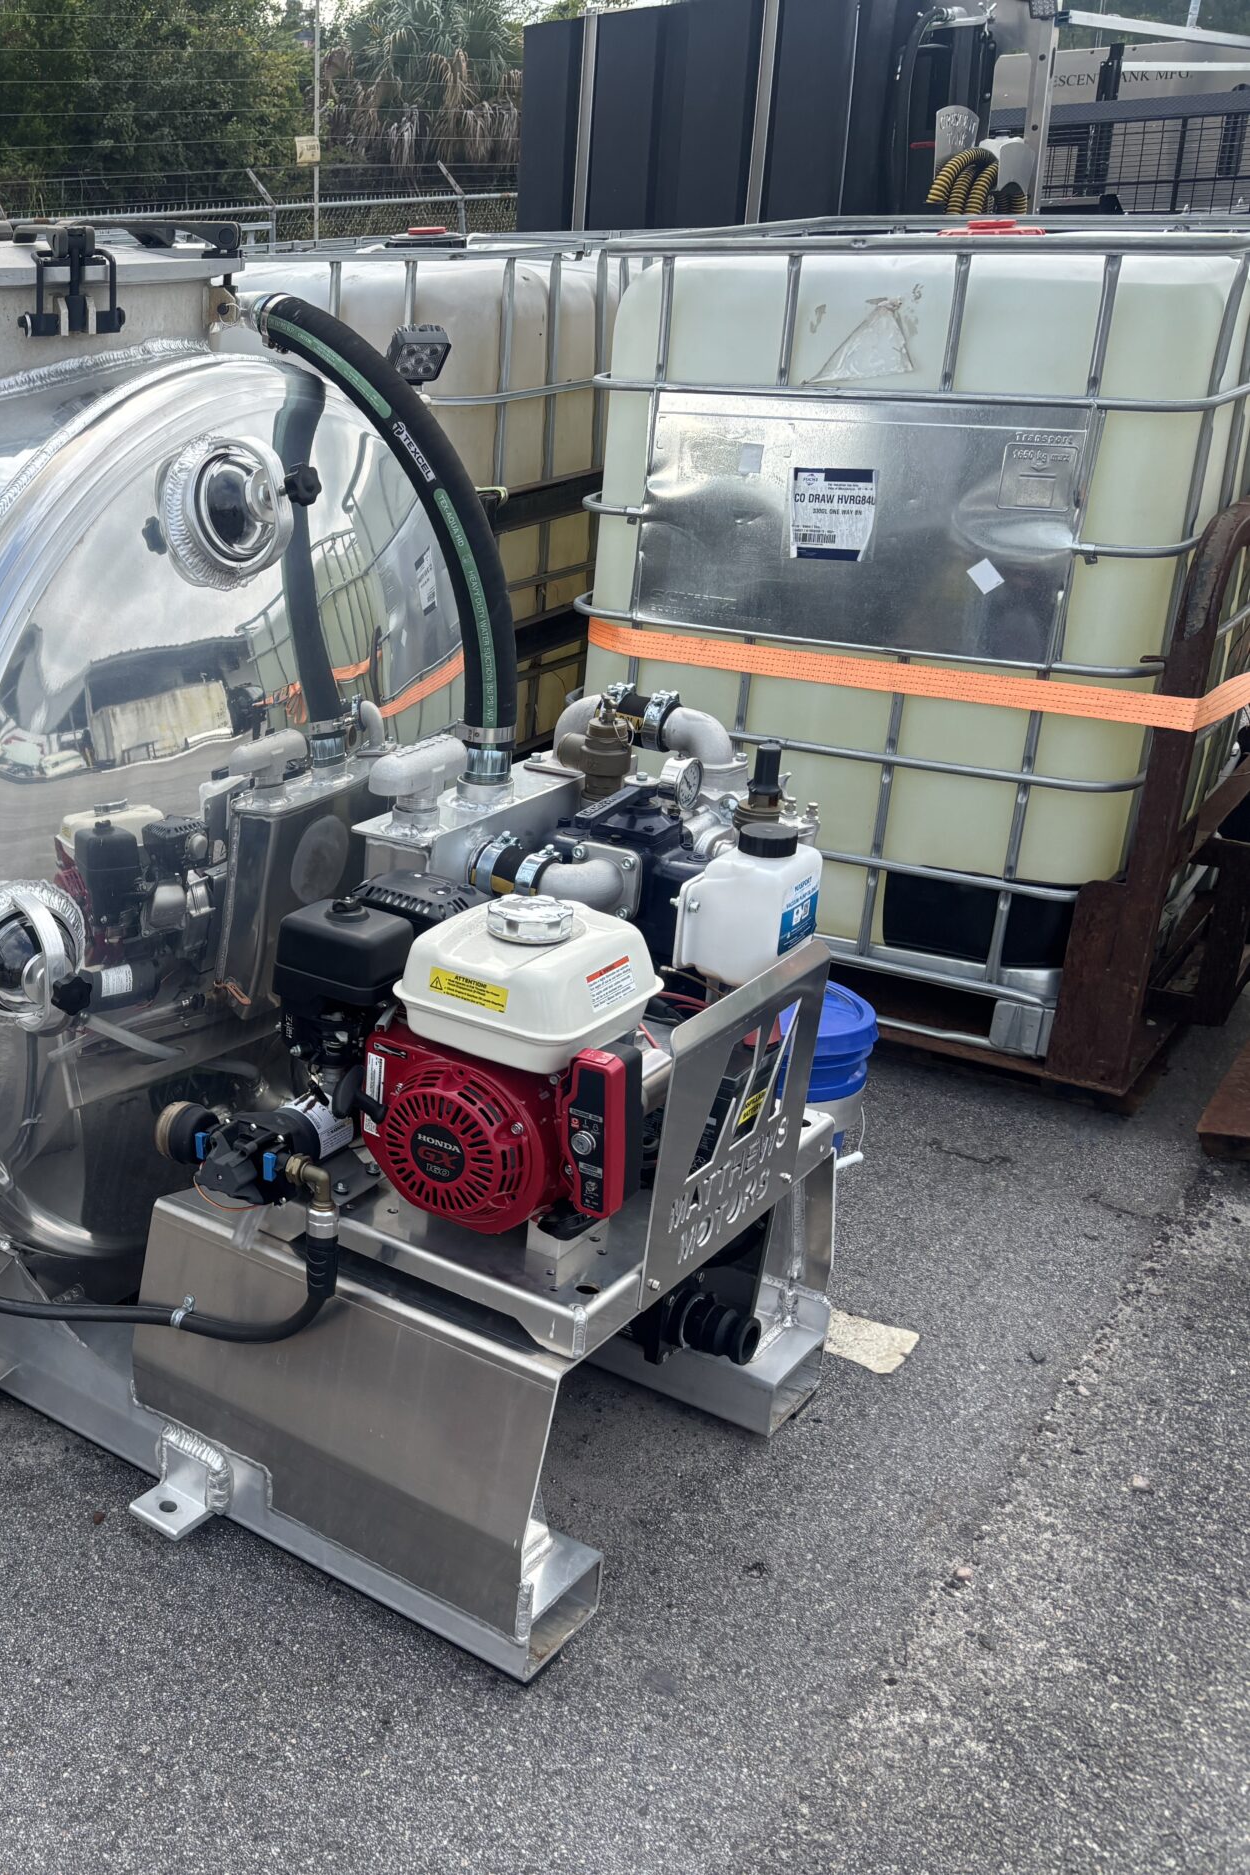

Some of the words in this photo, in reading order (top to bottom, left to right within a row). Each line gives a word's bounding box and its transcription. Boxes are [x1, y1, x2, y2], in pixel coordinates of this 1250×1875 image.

[1121, 71, 1150, 83] ANK
[1015, 431, 1073, 445] Transport
[403, 433, 434, 481] TEXCEL
[794, 493, 806, 503] CO
[808, 493, 835, 504] DRAW
[456, 534, 464, 547] HD
[468, 570, 481, 596] HEAVY
[475, 597, 485, 618] DUTY
[479, 619, 490, 646] WATER
[484, 647, 493, 681] SUCTION
[454, 975, 487, 989] ATTENTION!
[417, 1133, 462, 1153] HONDA
[417, 1145, 460, 1170] GX
[426, 1162, 450, 1177] 160
[668, 1116, 789, 1233] MATTHEWS
[678, 1168, 771, 1265] MOTORS
